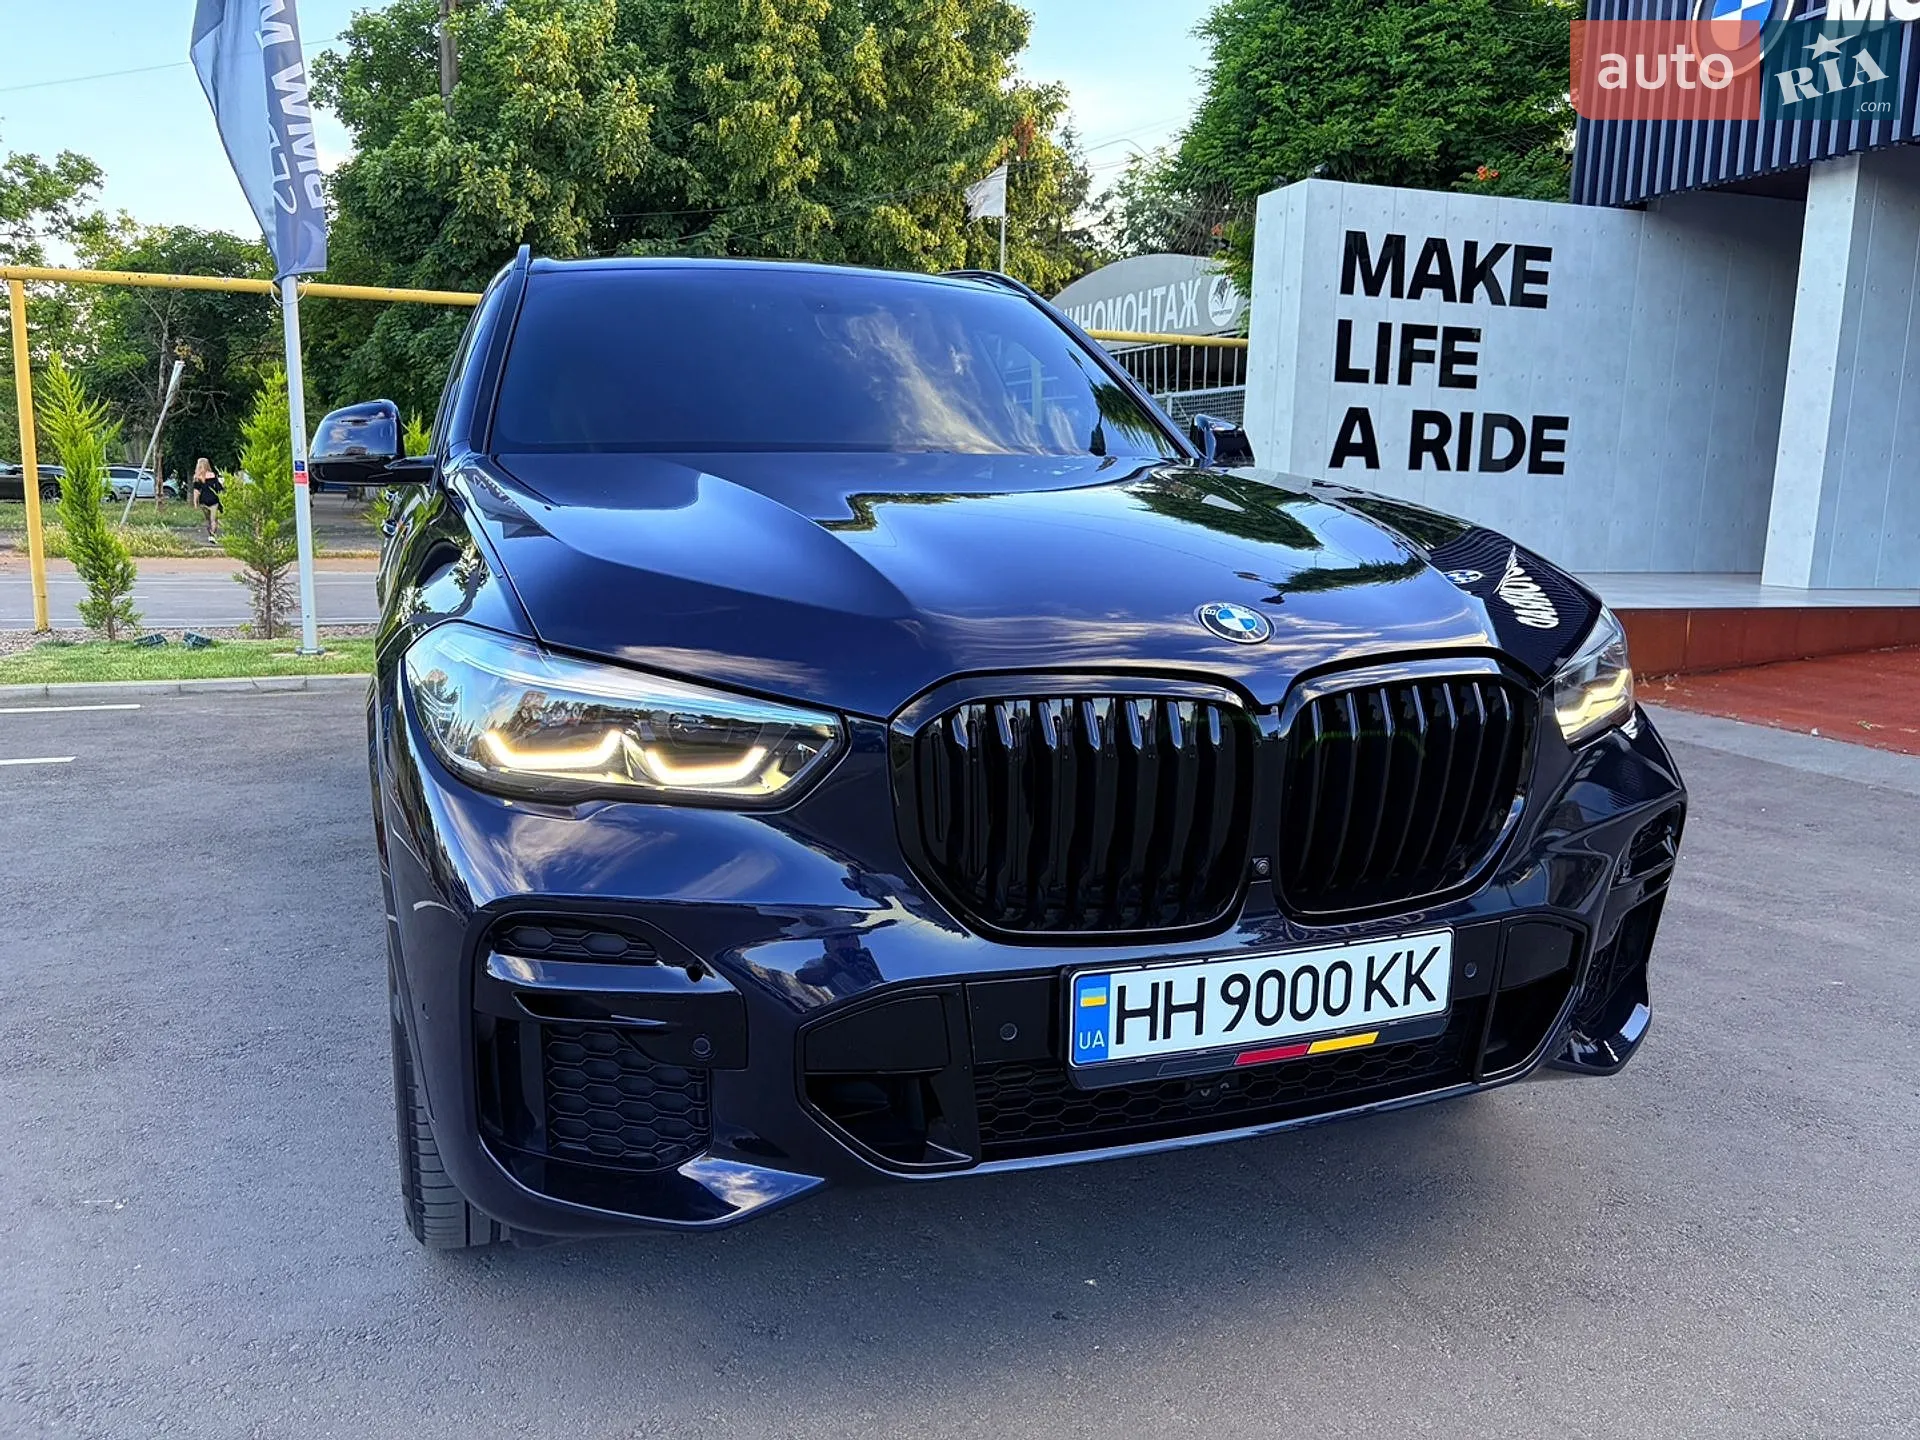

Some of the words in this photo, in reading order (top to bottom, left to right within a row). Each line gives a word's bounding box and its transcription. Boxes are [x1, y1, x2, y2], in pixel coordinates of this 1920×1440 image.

[1340, 230, 1553, 309] MAKE
[1334, 319, 1482, 389] LIFE
[1328, 407, 1380, 469] A
[1408, 409, 1570, 475] RIDE
[1115, 976, 1206, 1045] HH
[1220, 960, 1353, 1032] 9000
[1363, 946, 1441, 1012] KK
[1079, 1029, 1105, 1050] UA
